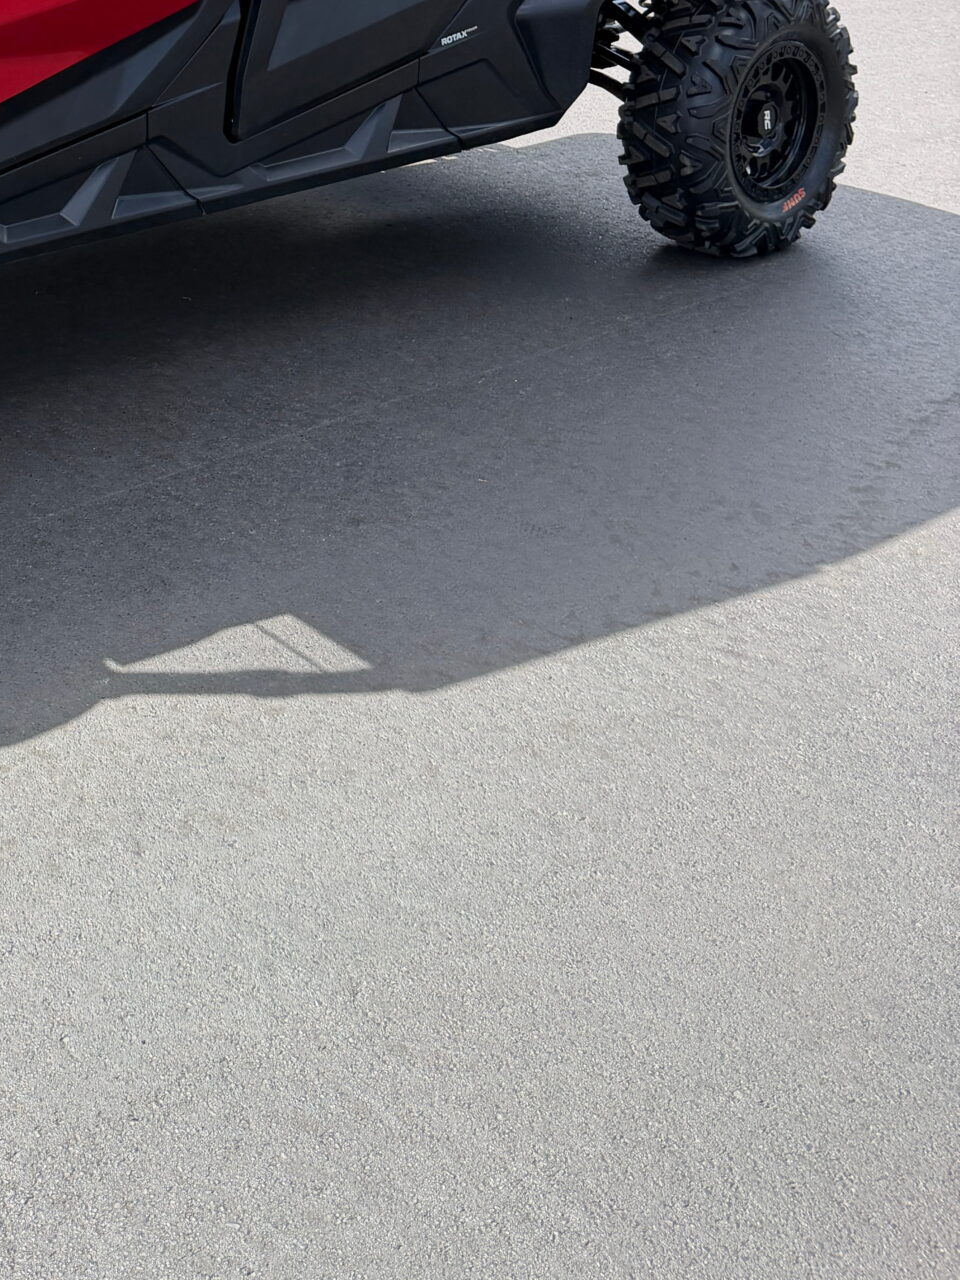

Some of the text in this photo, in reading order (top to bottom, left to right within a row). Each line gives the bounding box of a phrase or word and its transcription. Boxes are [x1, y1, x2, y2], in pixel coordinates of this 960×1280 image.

[441, 30, 468, 46] ROTAX
[763, 110, 772, 130] RC
[782, 187, 806, 212] SUNF
